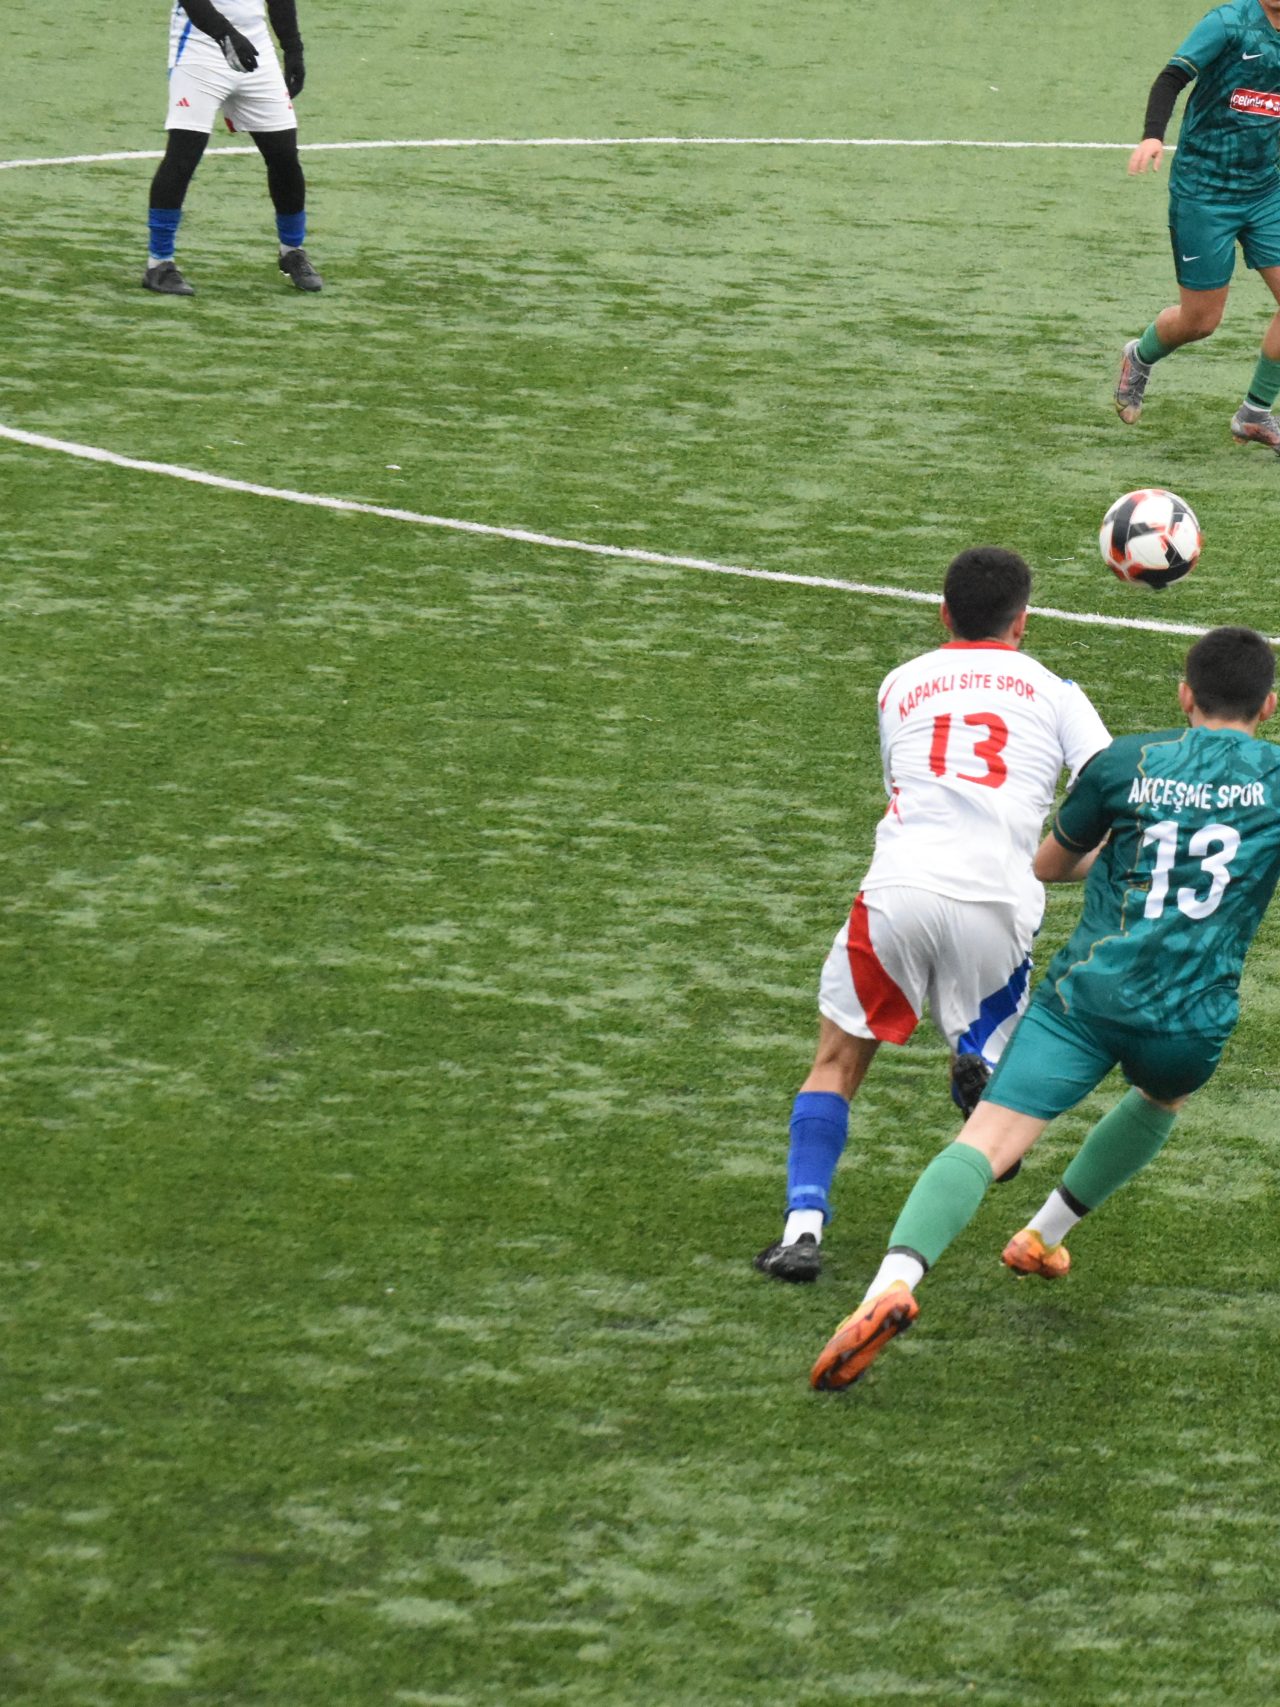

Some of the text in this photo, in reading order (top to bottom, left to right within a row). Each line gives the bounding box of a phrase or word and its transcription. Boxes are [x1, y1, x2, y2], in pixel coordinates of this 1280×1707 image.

[898, 669, 1036, 722] KAPAKLI SİTE SPOR
[929, 712, 1009, 790] 13
[1127, 777, 1266, 814] AKÇEŞME SPOR
[1142, 820, 1241, 920] 13
